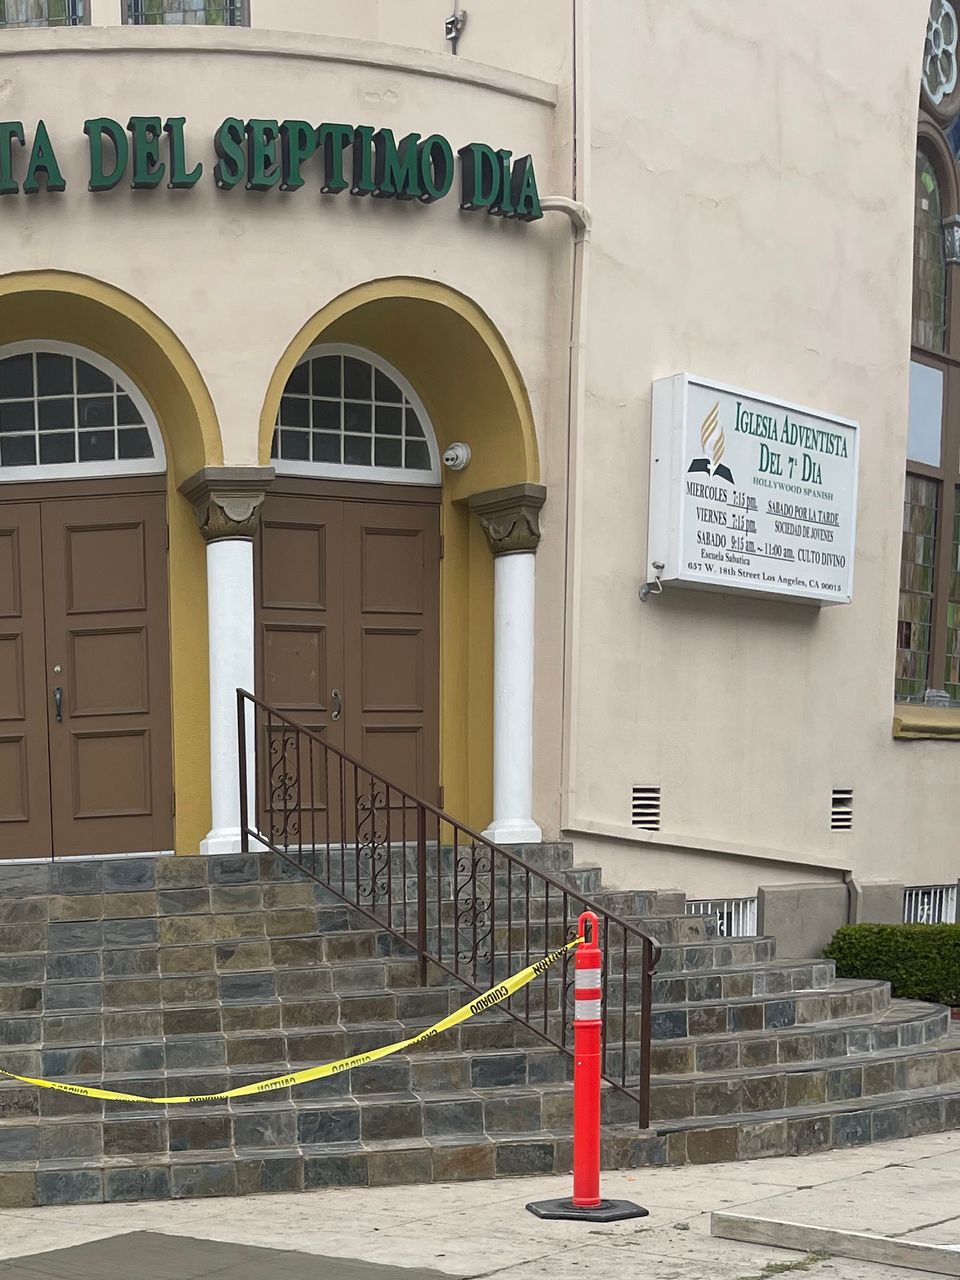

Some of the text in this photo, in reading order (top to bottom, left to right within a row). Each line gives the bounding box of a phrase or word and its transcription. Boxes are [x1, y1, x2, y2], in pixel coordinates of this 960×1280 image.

[84, 116, 203, 192] DEL
[214, 116, 455, 204] SEPTIMO
[458, 143, 543, 222] DIA
[735, 401, 848, 458] IGLESIA ADVENTISTA
[759, 443, 783, 476] DEL
[801, 453, 822, 485] DIA
[686, 481, 728, 503] MIERCOLES
[753, 476, 834, 501] HOLLYWOOD SPANISH
[696, 506, 728, 526] VIERNES
[768, 500, 840, 525] SABADO POR LA TARDE
[774, 520, 834, 543] SOCIEDAD DE JOVENES
[697, 530, 727, 548] SABADO
[797, 548, 821, 564] CULTO
[821, 552, 846, 569] DIVINO
[701, 548, 724, 562] Escuela
[719, 566, 736, 576] 18th
[738, 568, 760, 581] Street
[762, 572, 776, 582] Los
[777, 574, 808, 588] Angeles,
[809, 579, 820, 589] CA
[470, 985, 509, 1014] CUIDADO
